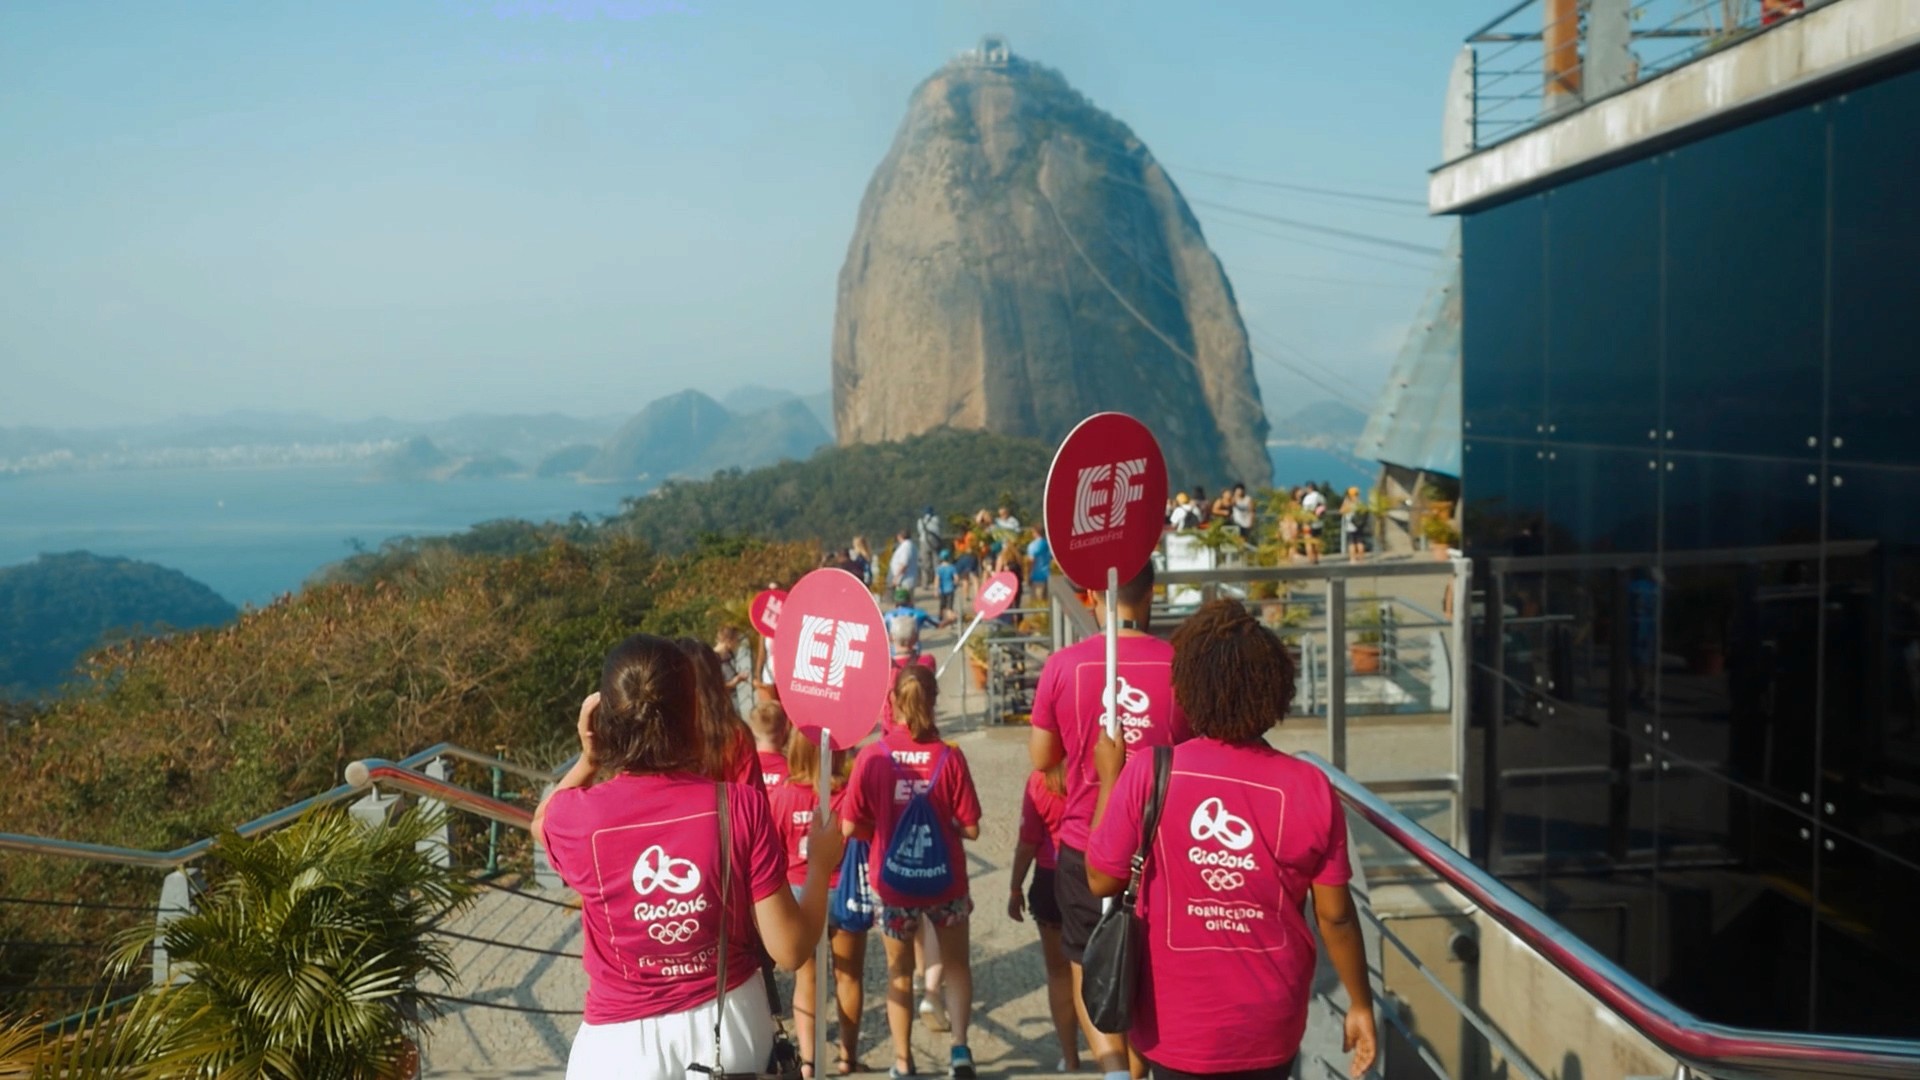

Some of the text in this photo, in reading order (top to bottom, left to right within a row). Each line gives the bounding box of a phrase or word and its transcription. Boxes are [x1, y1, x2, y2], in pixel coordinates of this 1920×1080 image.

[1071, 457, 1147, 537] EF
[983, 580, 1012, 603] EF
[793, 614, 870, 688] EF
[790, 680, 825, 697] Education
[891, 750, 931, 764] STAFF
